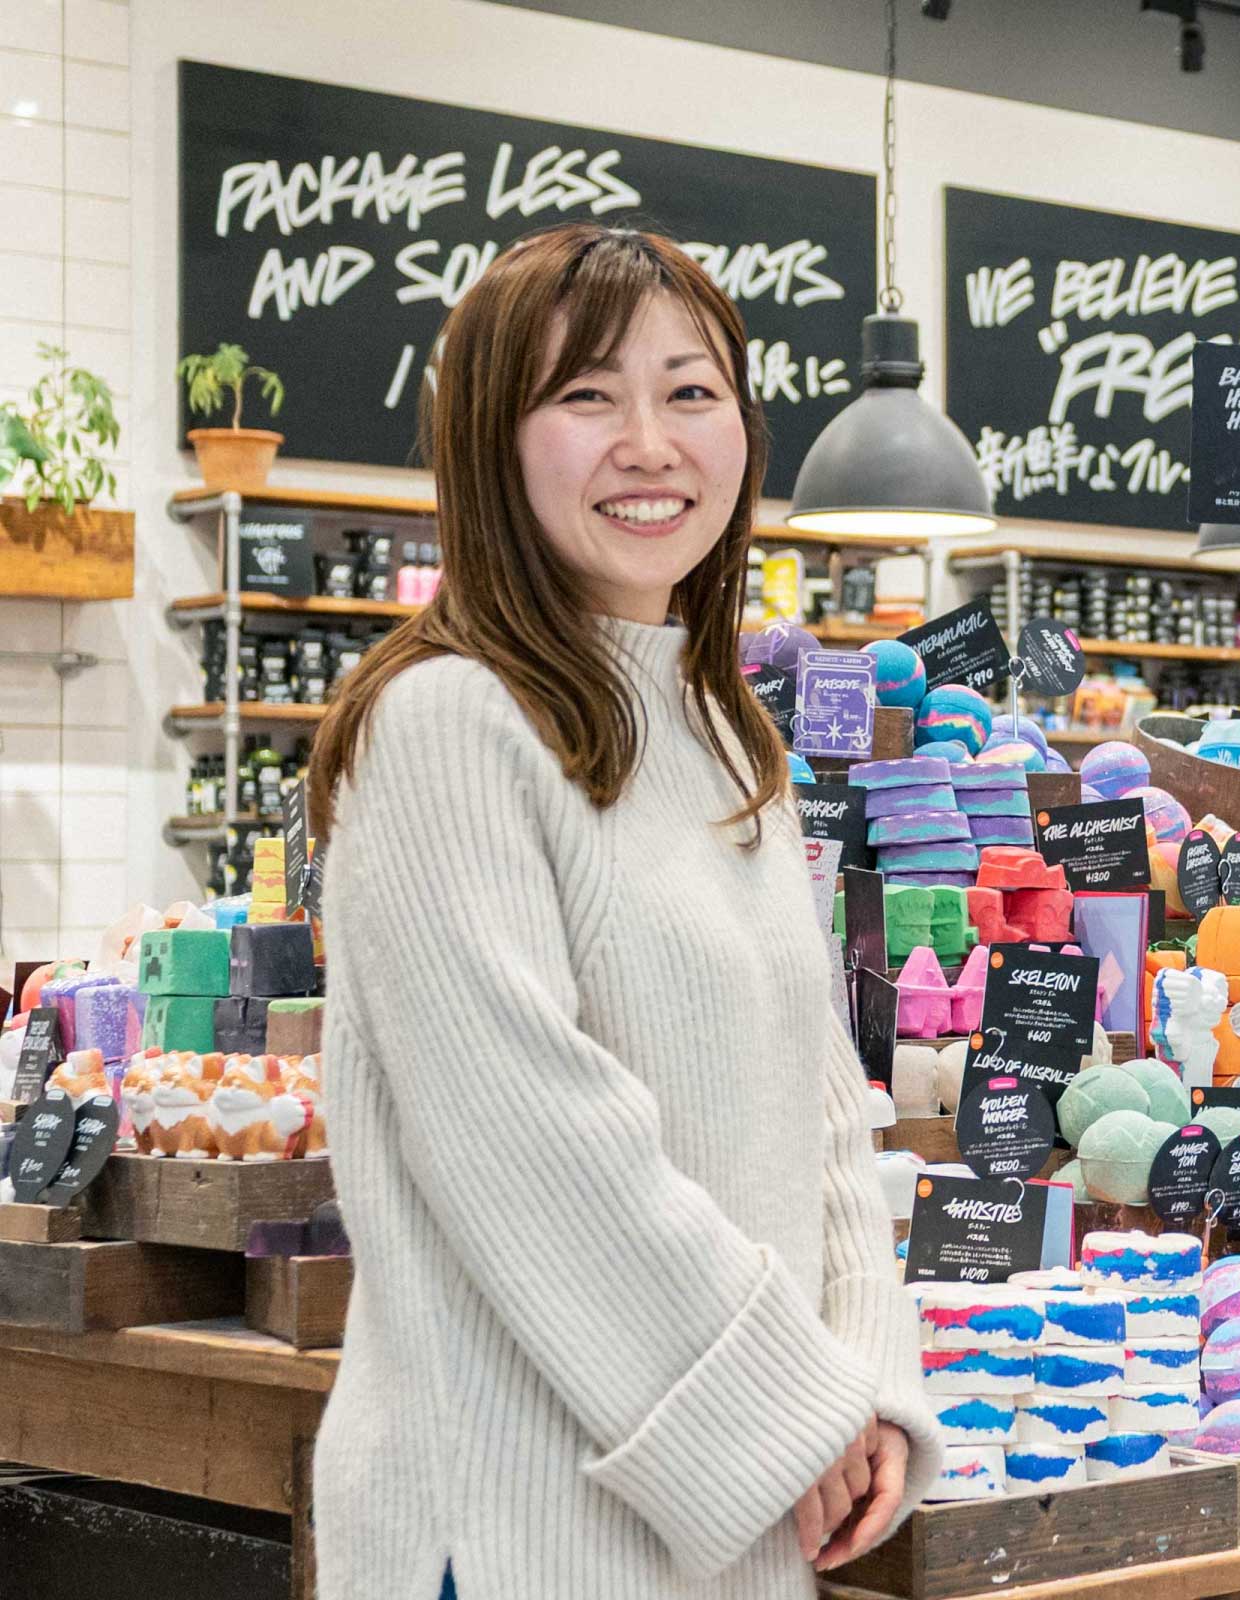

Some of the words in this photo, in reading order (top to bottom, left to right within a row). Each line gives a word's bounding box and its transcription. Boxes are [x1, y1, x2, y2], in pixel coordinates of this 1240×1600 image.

[216, 151, 466, 236] PACKAGE
[486, 143, 641, 218] LESS
[248, 245, 374, 321] AND
[395, 239, 527, 308] SOL
[680, 239, 845, 308] DUCTS
[966, 258, 1035, 328] WE
[1052, 254, 1239, 320] BELIEVE
[1043, 823, 1068, 842] THE
[1070, 814, 1141, 838] ALCHEMIST
[1008, 969, 1080, 992] SKELETON
[1027, 1030, 1051, 1042] ¥600
[1004, 1060, 1022, 1073] OF
[1020, 1063, 1076, 1085] MISRULE
[979, 1093, 1029, 1112] GOLDEN
[982, 1108, 1029, 1125] WONDER
[990, 1159, 1019, 1173] ¥2500
[1178, 1156, 1197, 1168] TOM
